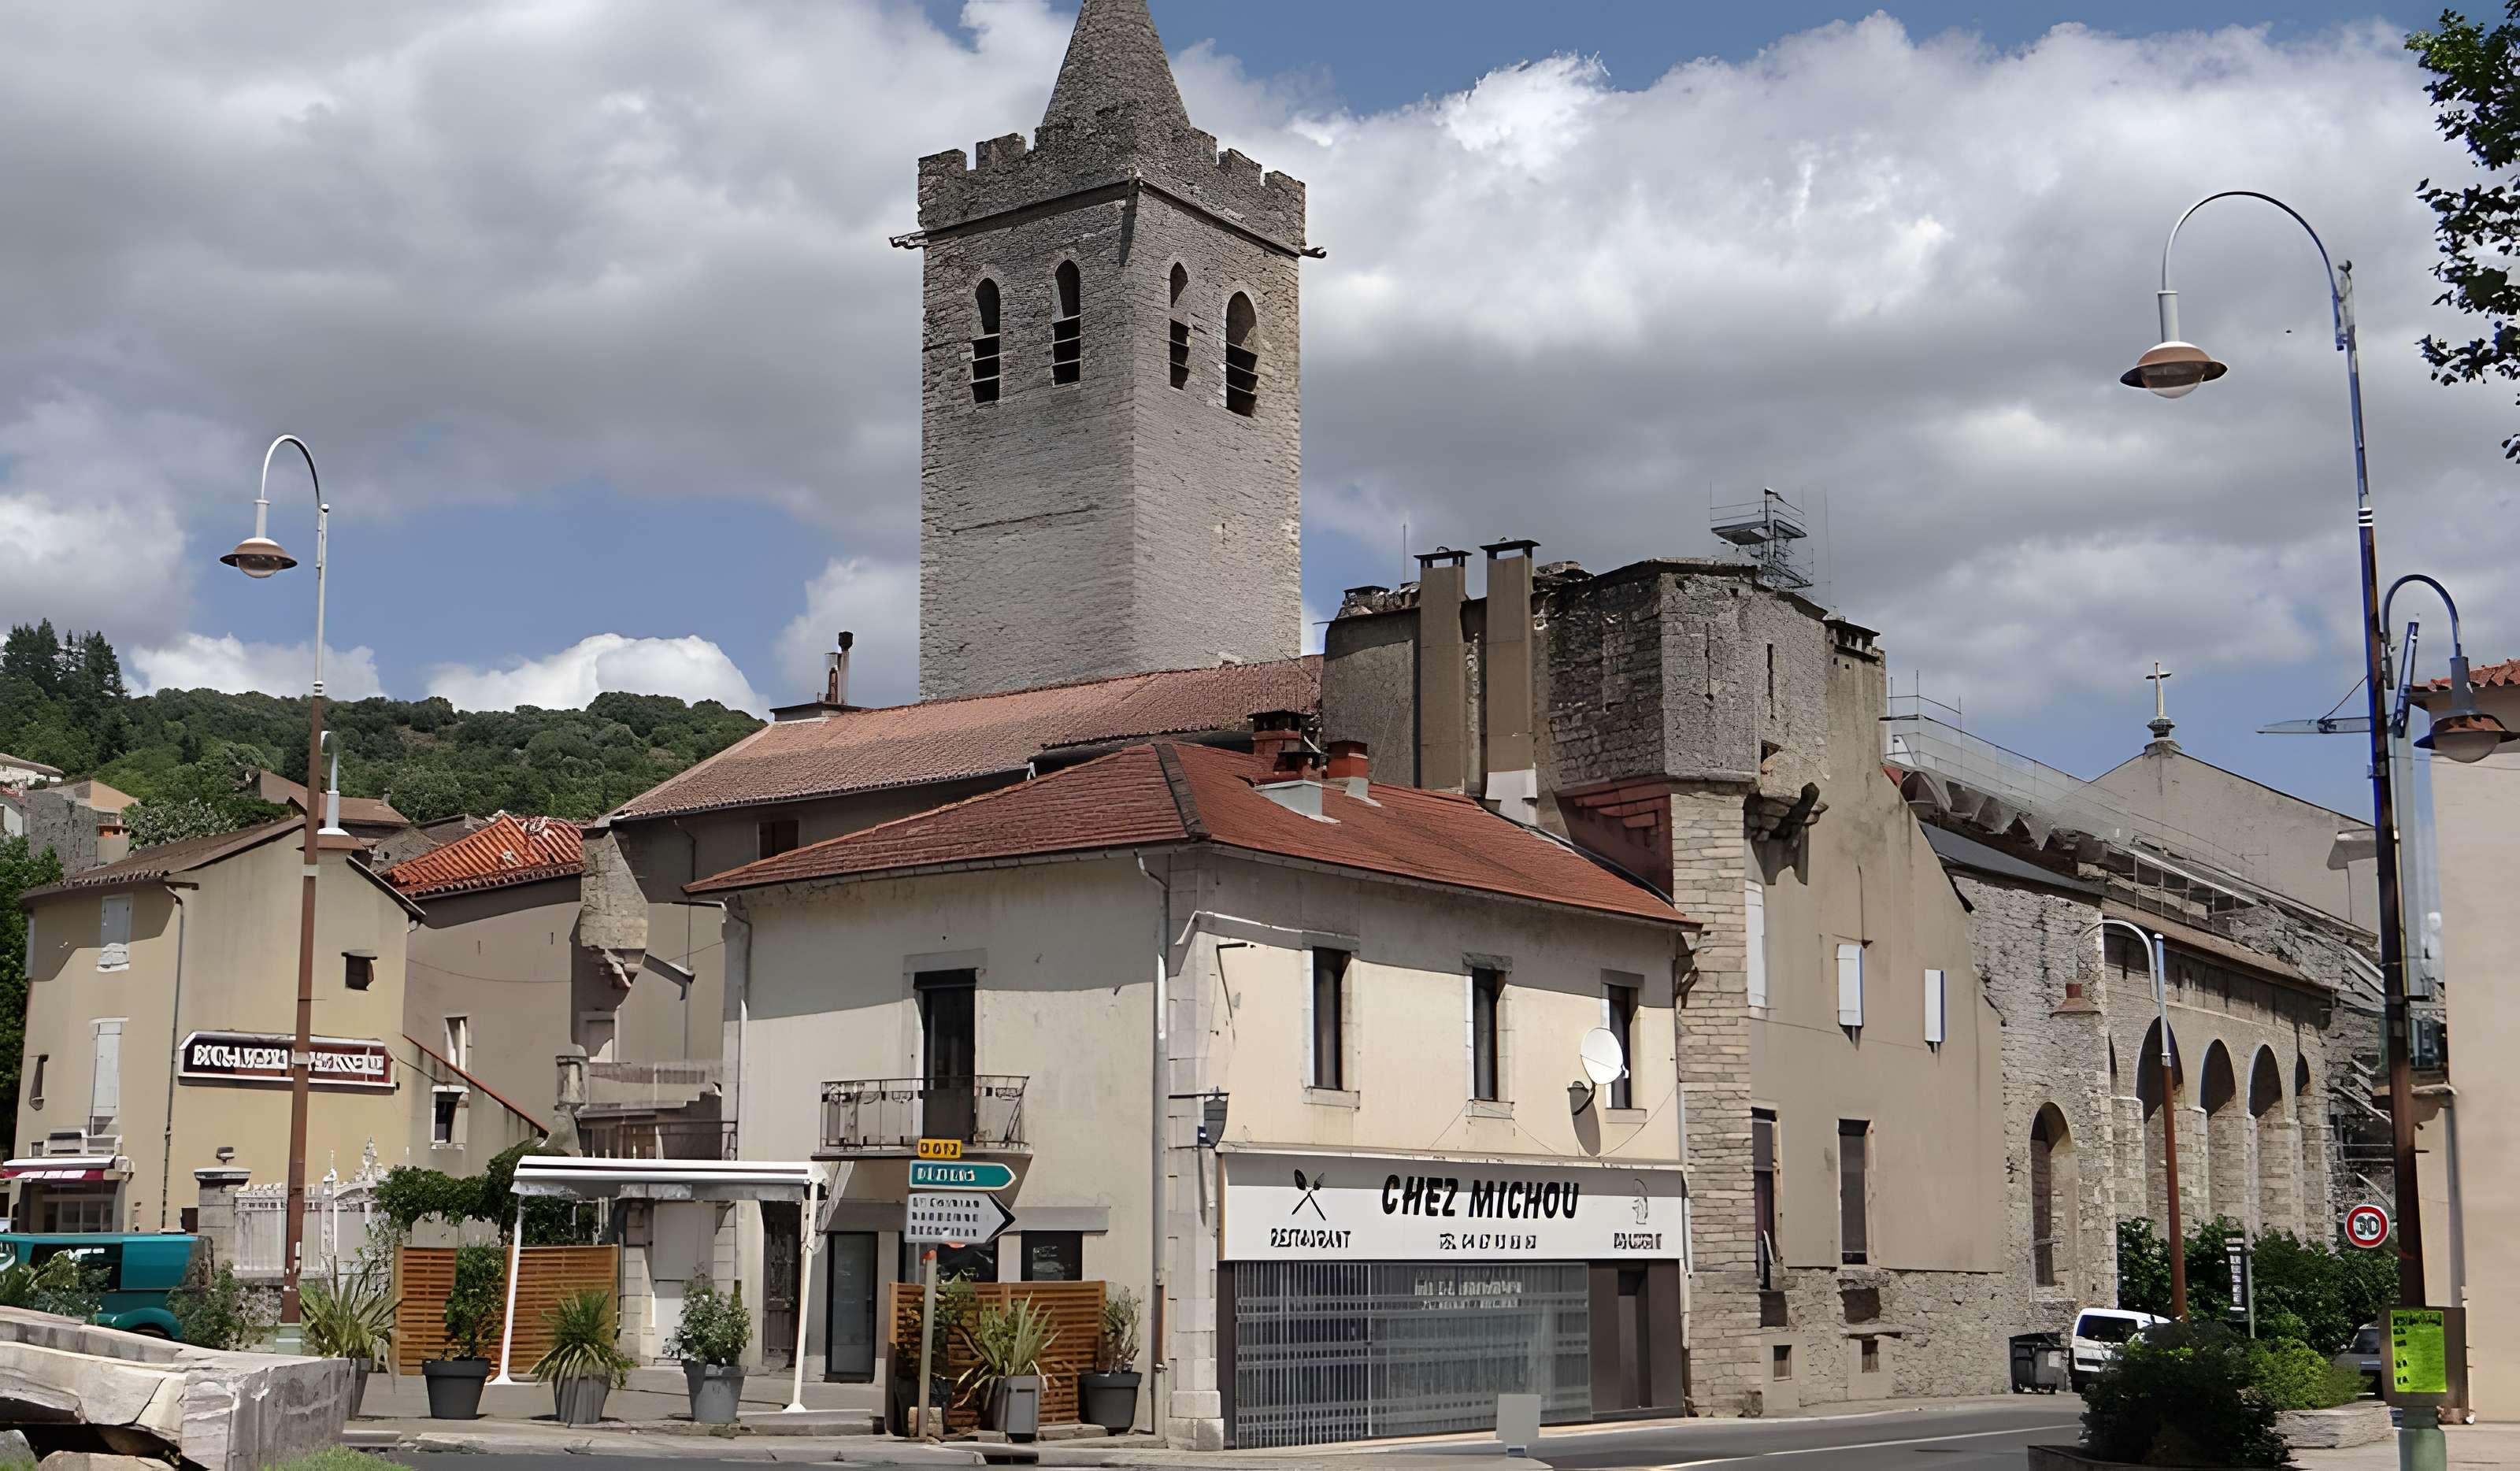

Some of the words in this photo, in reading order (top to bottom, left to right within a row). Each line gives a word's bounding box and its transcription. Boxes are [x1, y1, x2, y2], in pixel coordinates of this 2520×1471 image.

[1382, 1174, 1458, 1217] CHEZ
[1468, 1180, 1580, 1219] MICHOU
[2355, 1215, 2380, 1235] 30
